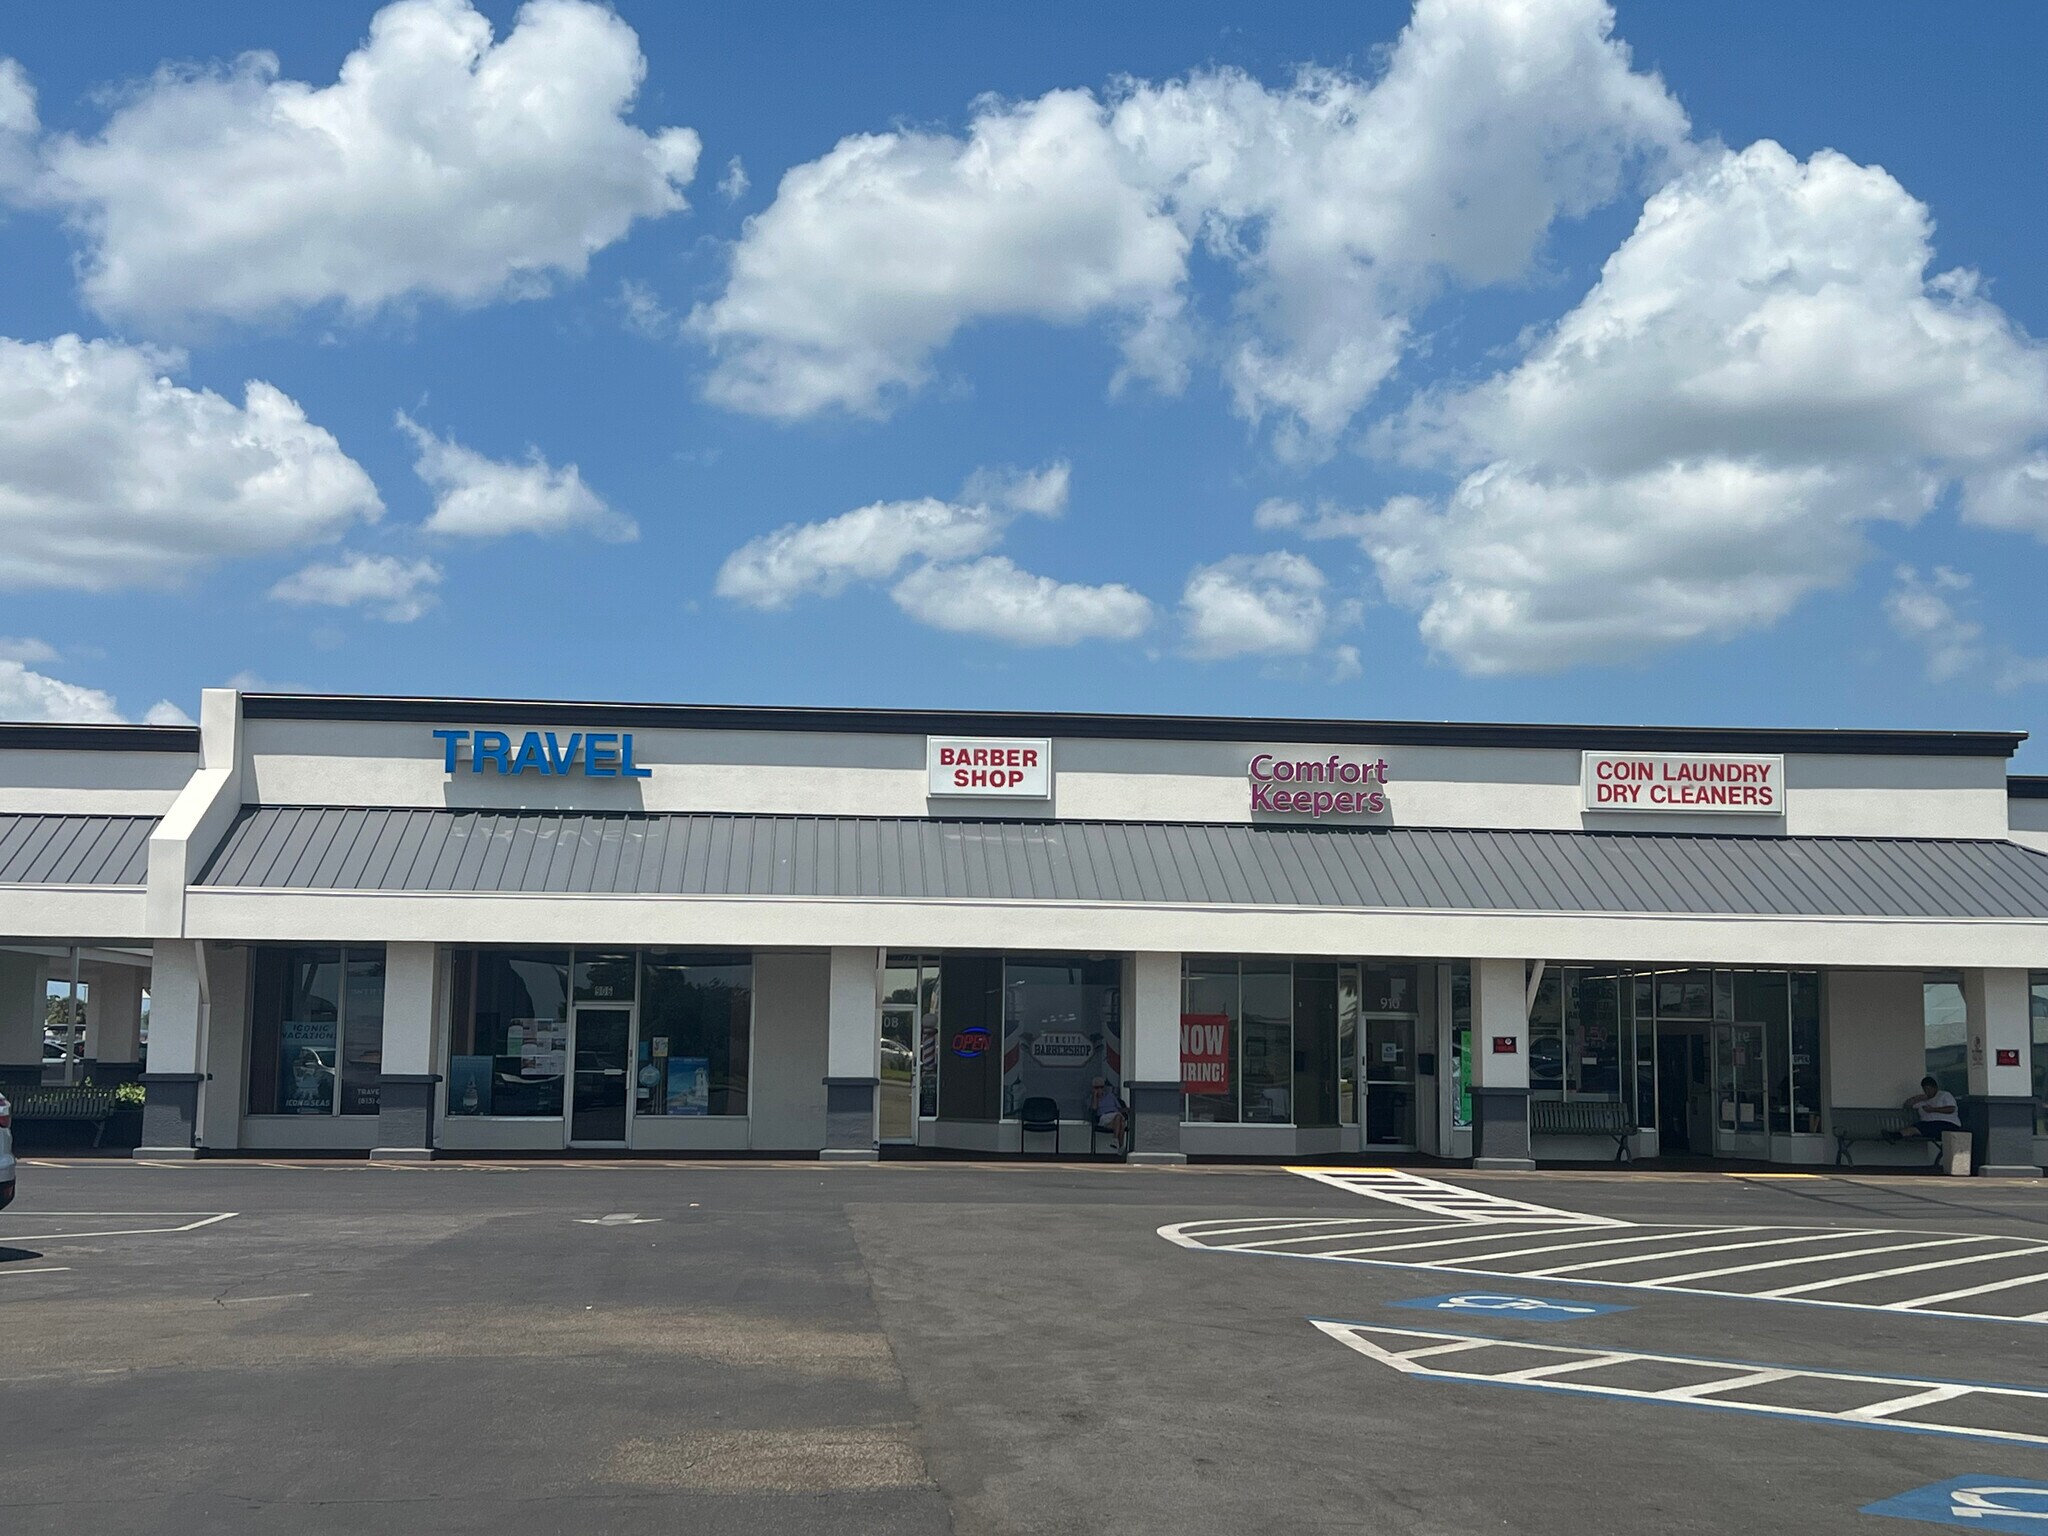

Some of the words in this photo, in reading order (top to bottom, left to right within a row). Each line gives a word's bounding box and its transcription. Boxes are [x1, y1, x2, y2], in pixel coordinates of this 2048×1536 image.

[433, 729, 652, 778] TRAVEL
[940, 748, 1037, 767] BARBER
[954, 769, 1024, 787] SHOP
[1250, 754, 1388, 784] Comfort
[1596, 761, 1653, 780] COIN
[1663, 763, 1771, 783] LAUNDRY
[1251, 783, 1385, 817] Keepers
[1597, 784, 1641, 803] DRY
[1650, 785, 1773, 805] CLEANERS
[1380, 997, 1400, 1009] 910
[952, 1034, 991, 1050] OPEN
[1180, 1024, 1225, 1055] NOW
[1034, 1044, 1092, 1056] BARBERSHOP
[1180, 1062, 1225, 1082] IRING!
[285, 1099, 303, 1107] ICON
[310, 1099, 330, 1107] SEAS
